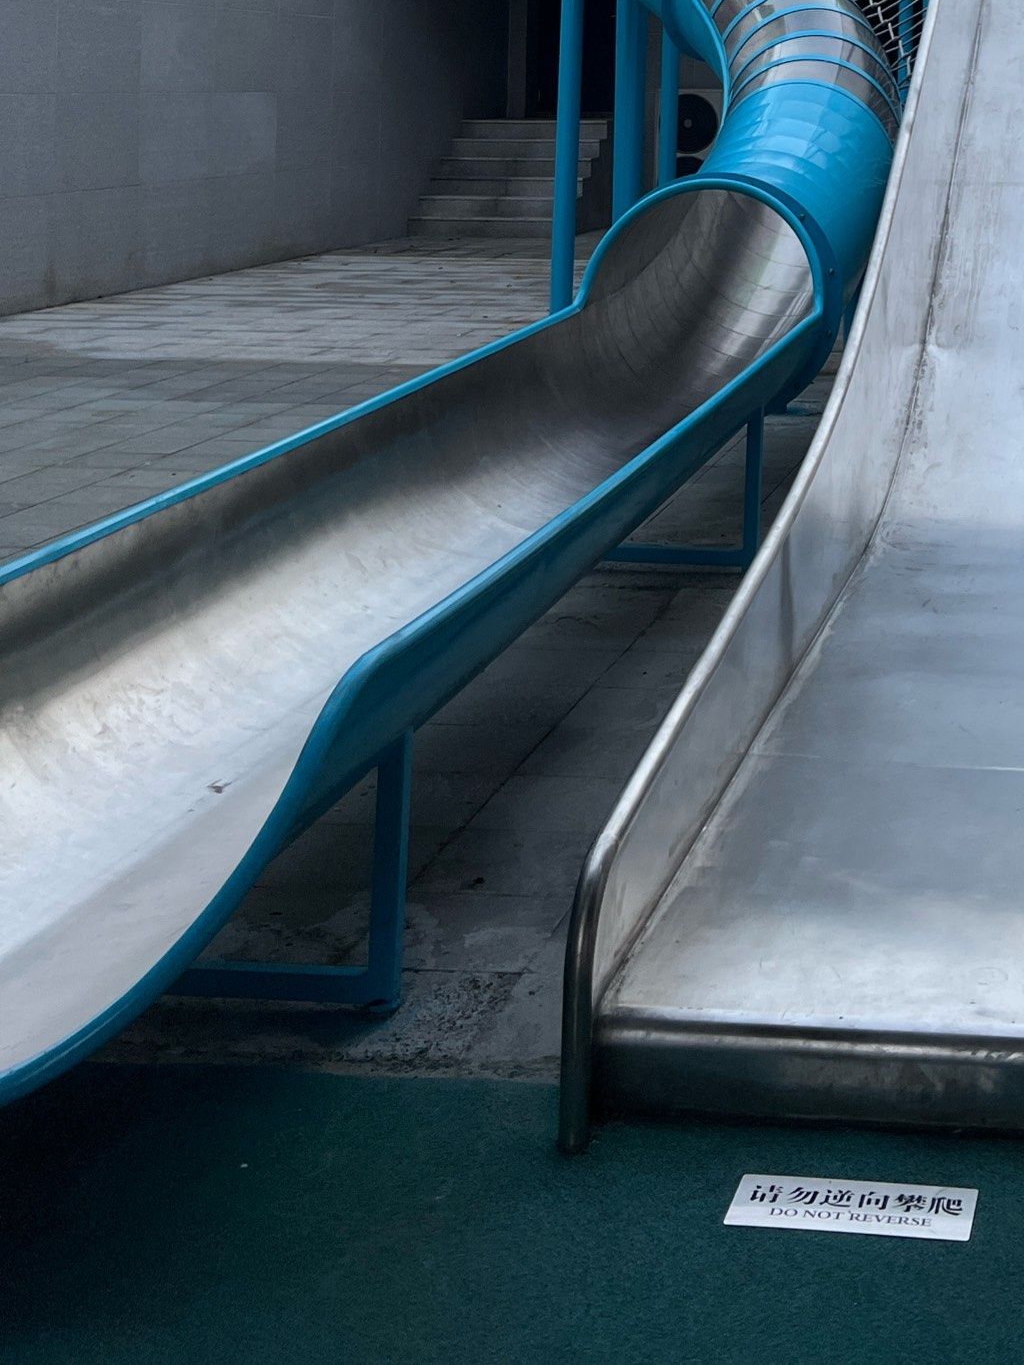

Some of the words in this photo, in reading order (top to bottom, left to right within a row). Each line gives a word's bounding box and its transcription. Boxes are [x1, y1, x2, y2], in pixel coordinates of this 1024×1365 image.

[750, 1184, 963, 1216] 请勿逆向攀爬
[769, 1207, 798, 1217] DO
[803, 1209, 847, 1221] NOT
[849, 1212, 932, 1227] REVERSE
